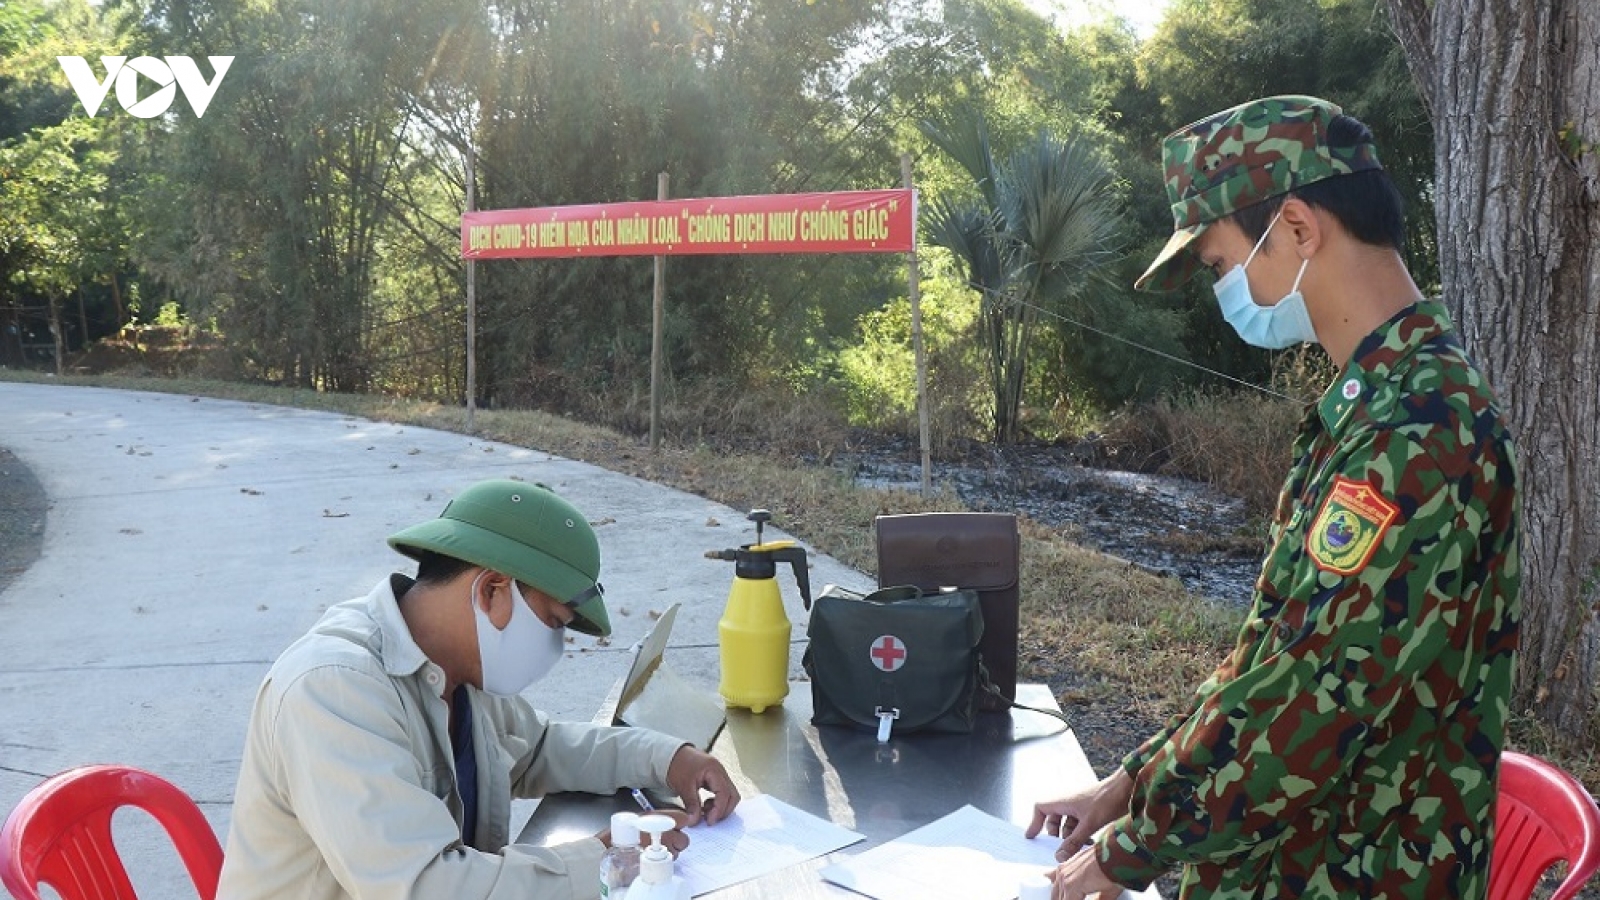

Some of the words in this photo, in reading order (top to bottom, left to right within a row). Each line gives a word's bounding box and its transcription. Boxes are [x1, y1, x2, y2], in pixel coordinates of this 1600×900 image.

[493, 223, 537, 249] COVID-19
[592, 210, 614, 246] CỦA
[617, 212, 649, 245] NHÂN
[734, 212, 764, 249] DỊCH
[768, 208, 798, 242] NHƯ
[800, 199, 848, 241] CHỐNG
